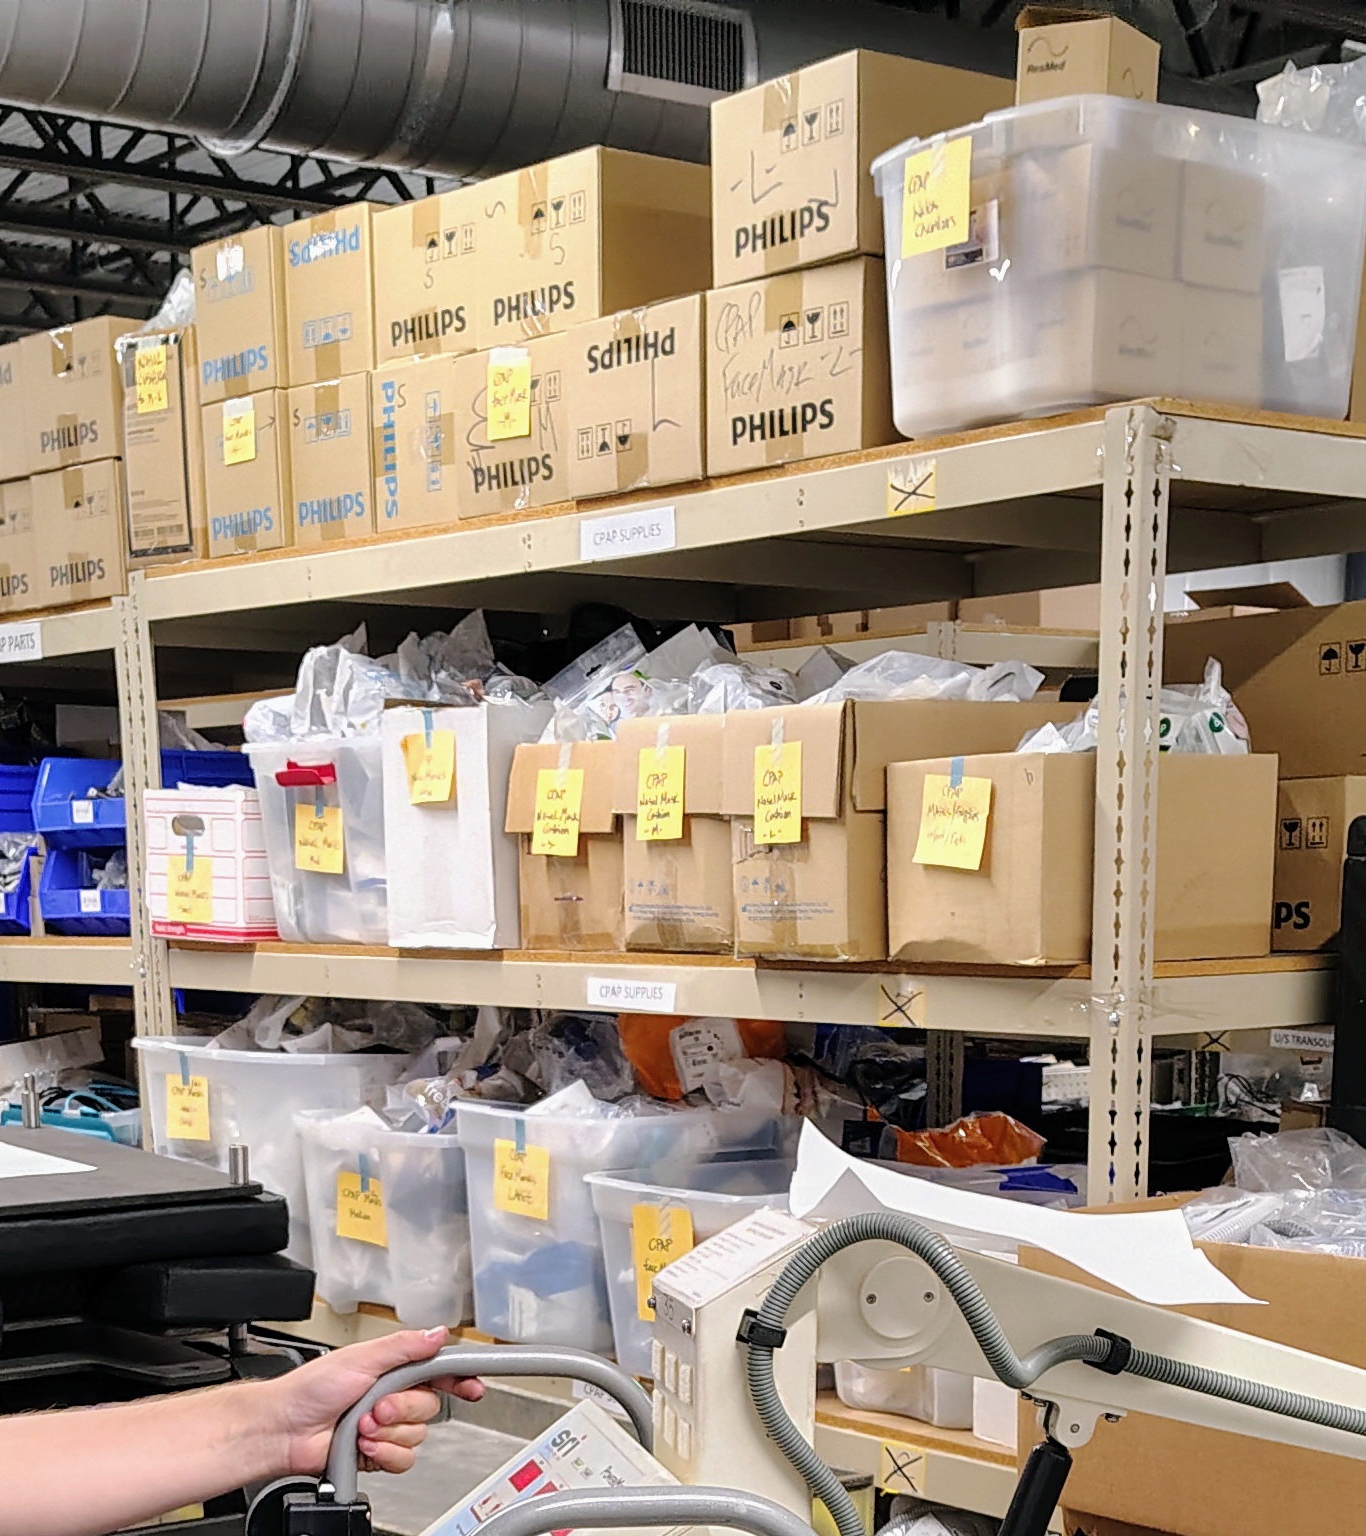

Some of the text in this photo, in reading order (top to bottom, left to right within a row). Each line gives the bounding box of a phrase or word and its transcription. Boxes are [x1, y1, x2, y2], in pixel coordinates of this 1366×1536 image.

[1026, 59, 1067, 75] ResMed
[289, 224, 360, 267] PHPS
[735, 204, 830, 258] PHILIPS
[493, 281, 576, 326] PHILIPS
[391, 305, 467, 347] PHILIPS
[203, 345, 268, 385] PHILIPS
[586, 327, 676, 373] PHILIPS
[40, 419, 98, 453] PHILIPS
[731, 398, 835, 446] PHILIPS
[381, 381, 398, 519] PHILIPS
[474, 454, 553, 493] PHILIPS
[212, 506, 273, 541] PHILIPS
[298, 491, 365, 527] PHILIPS
[594, 523, 662, 546] CPAP SUPPLIES
[50, 558, 106, 587] PHILIPS
[8, 632, 36, 651] PARTS
[599, 985, 664, 1000] CPAP SUPPLIES
[648, 1238, 673, 1251] CPAP
